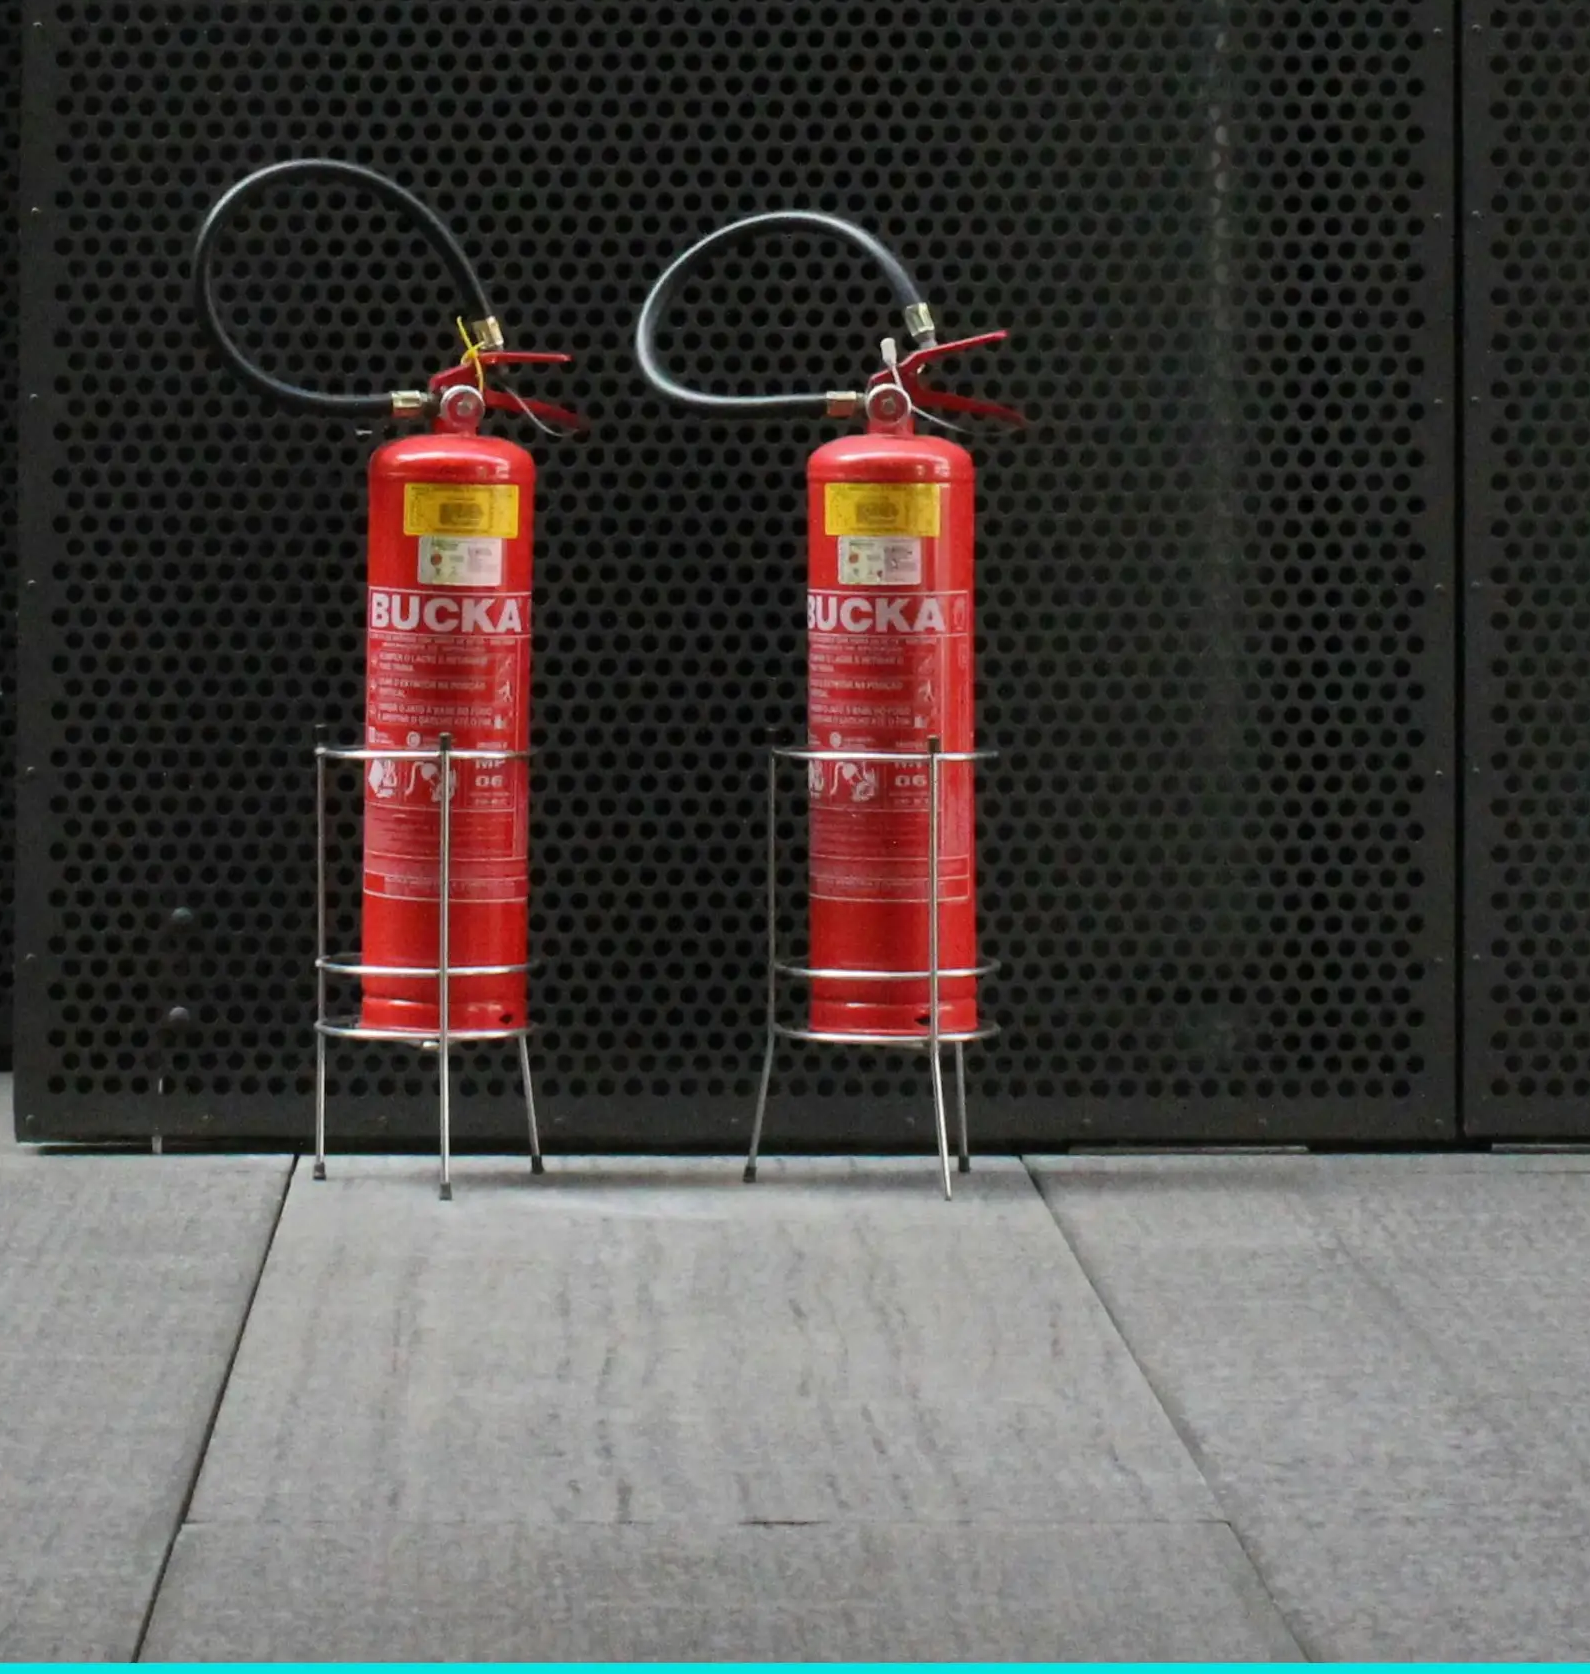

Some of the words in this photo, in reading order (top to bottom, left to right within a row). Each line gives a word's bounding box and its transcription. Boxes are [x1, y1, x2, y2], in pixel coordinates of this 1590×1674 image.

[371, 592, 523, 633] BUCKA
[475, 775, 503, 787] 06
[895, 775, 927, 787] 06
